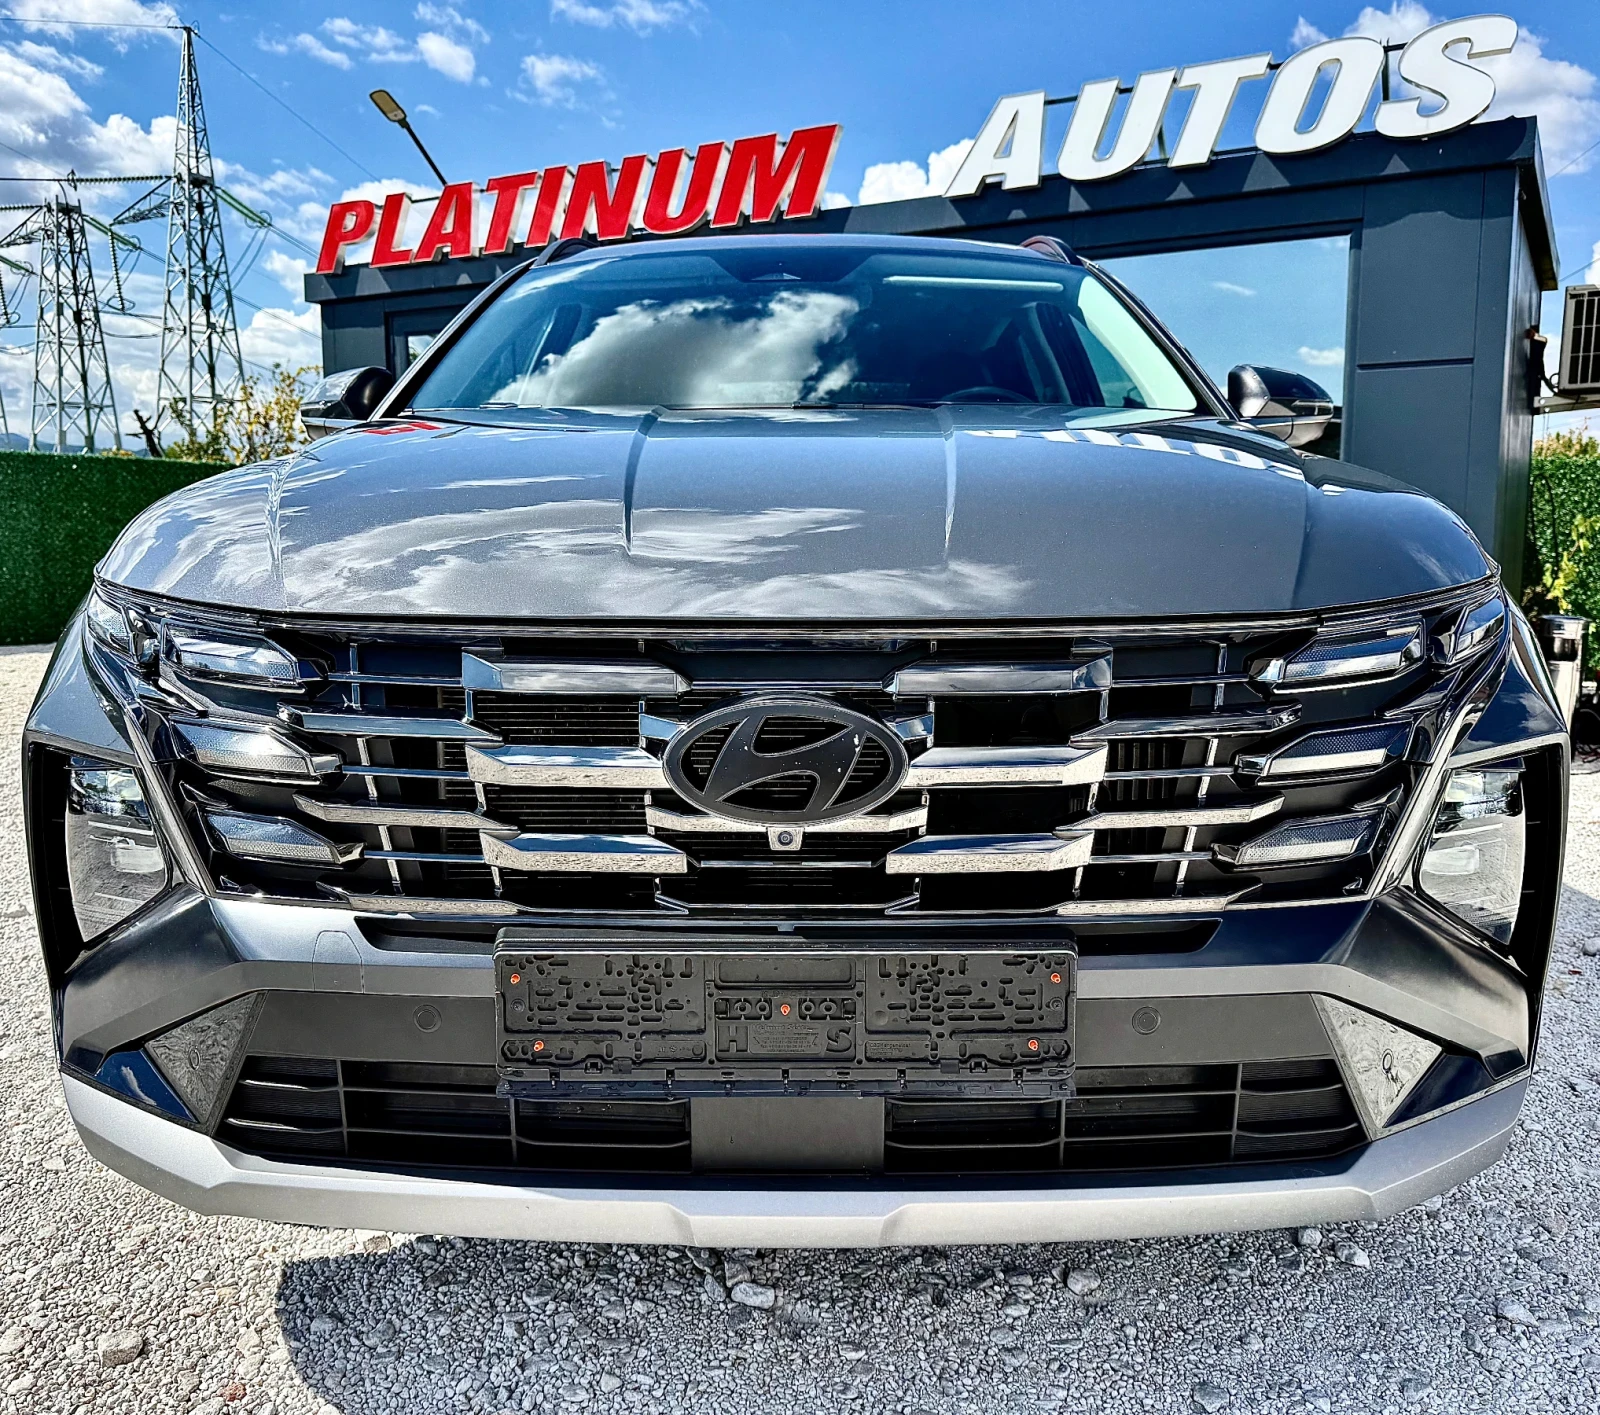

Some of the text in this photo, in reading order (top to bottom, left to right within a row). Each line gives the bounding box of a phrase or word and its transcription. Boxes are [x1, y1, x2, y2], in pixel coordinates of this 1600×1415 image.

[315, 14, 1519, 275] PLATINUM AUTOS
[717, 1025, 749, 1053] H
[826, 1026, 853, 1053] S
